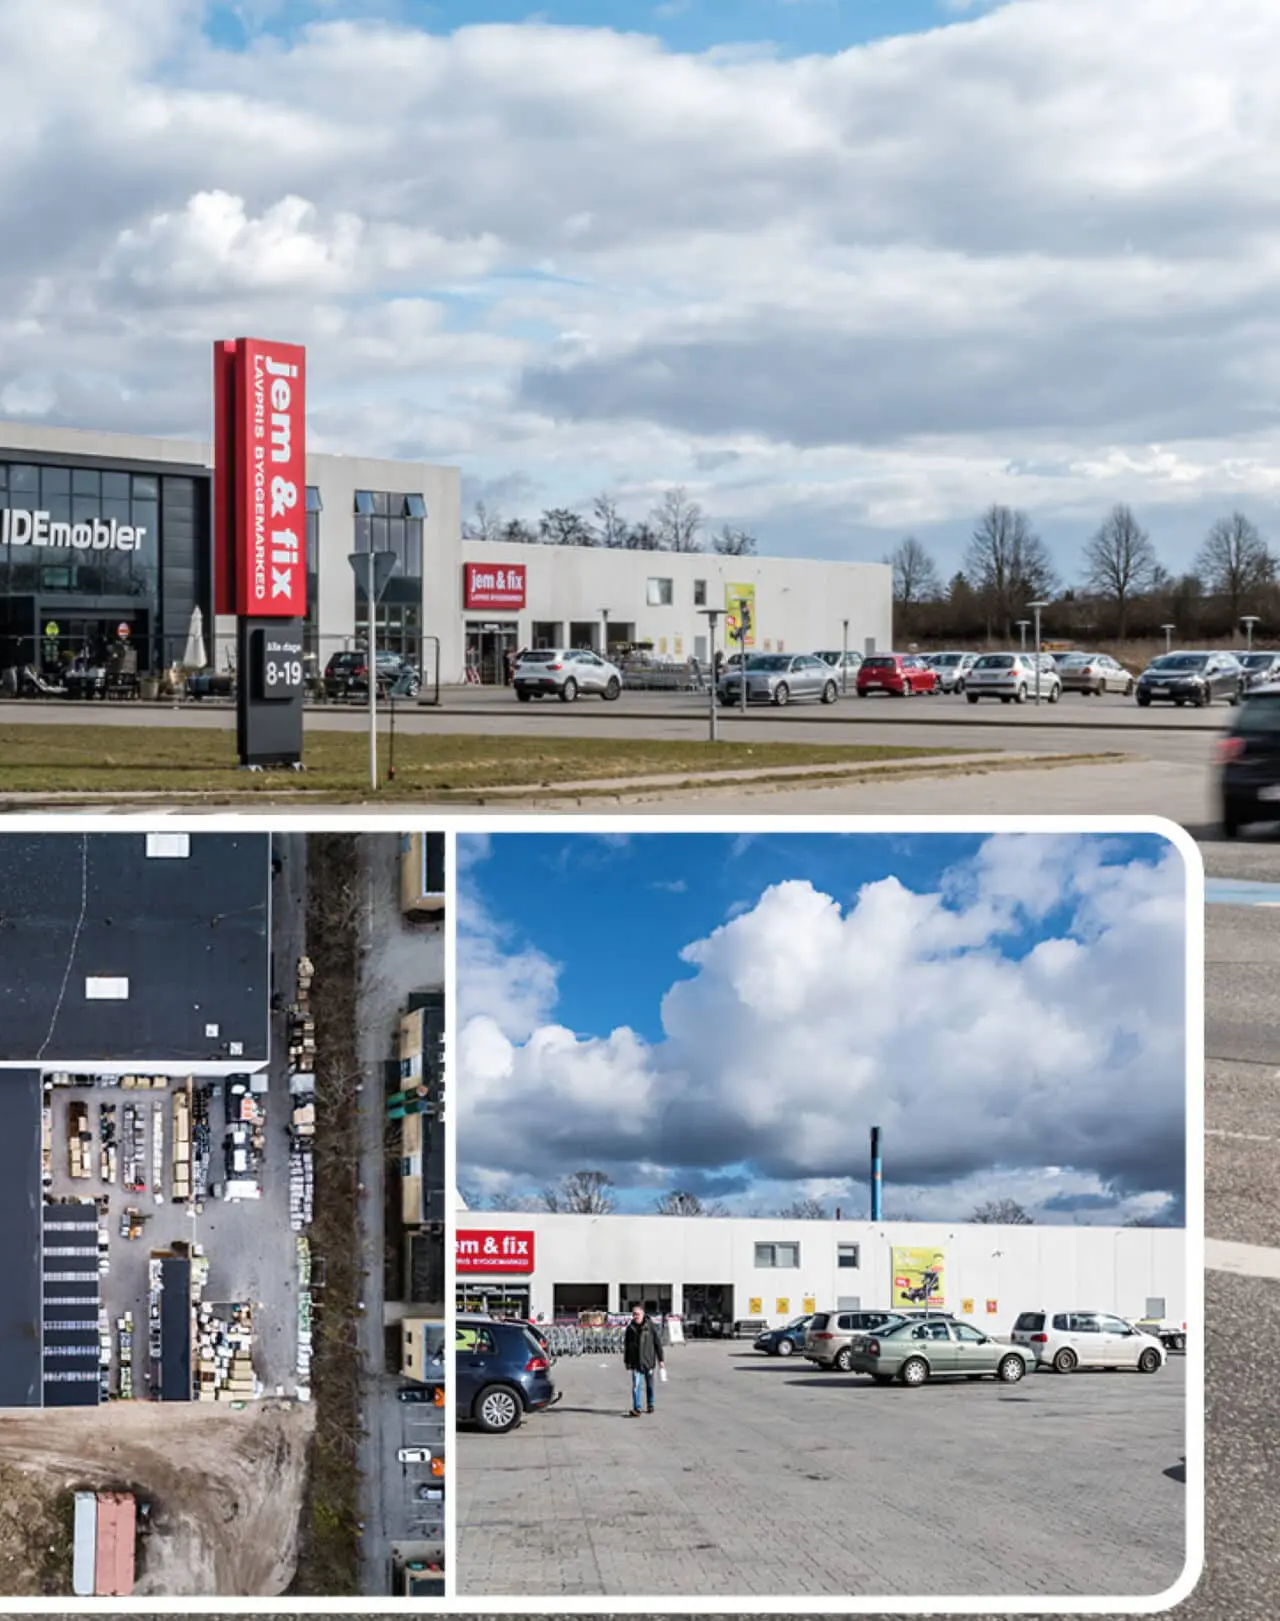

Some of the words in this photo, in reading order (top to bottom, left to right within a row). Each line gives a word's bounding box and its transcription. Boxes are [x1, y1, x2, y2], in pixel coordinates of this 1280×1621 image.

[254, 354, 265, 438] LAVPRIS
[265, 356, 298, 463] jem
[271, 475, 297, 518] &
[1, 508, 147, 551] IDEmøbler
[254, 446, 265, 600] BYGGEMARKED
[271, 528, 298, 599] fix
[471, 568, 494, 593] jem
[496, 570, 505, 590] &
[507, 569, 523, 590] fix
[266, 661, 301, 685] 8-19
[483, 1236, 498, 1254] &
[503, 1235, 528, 1254] fix
